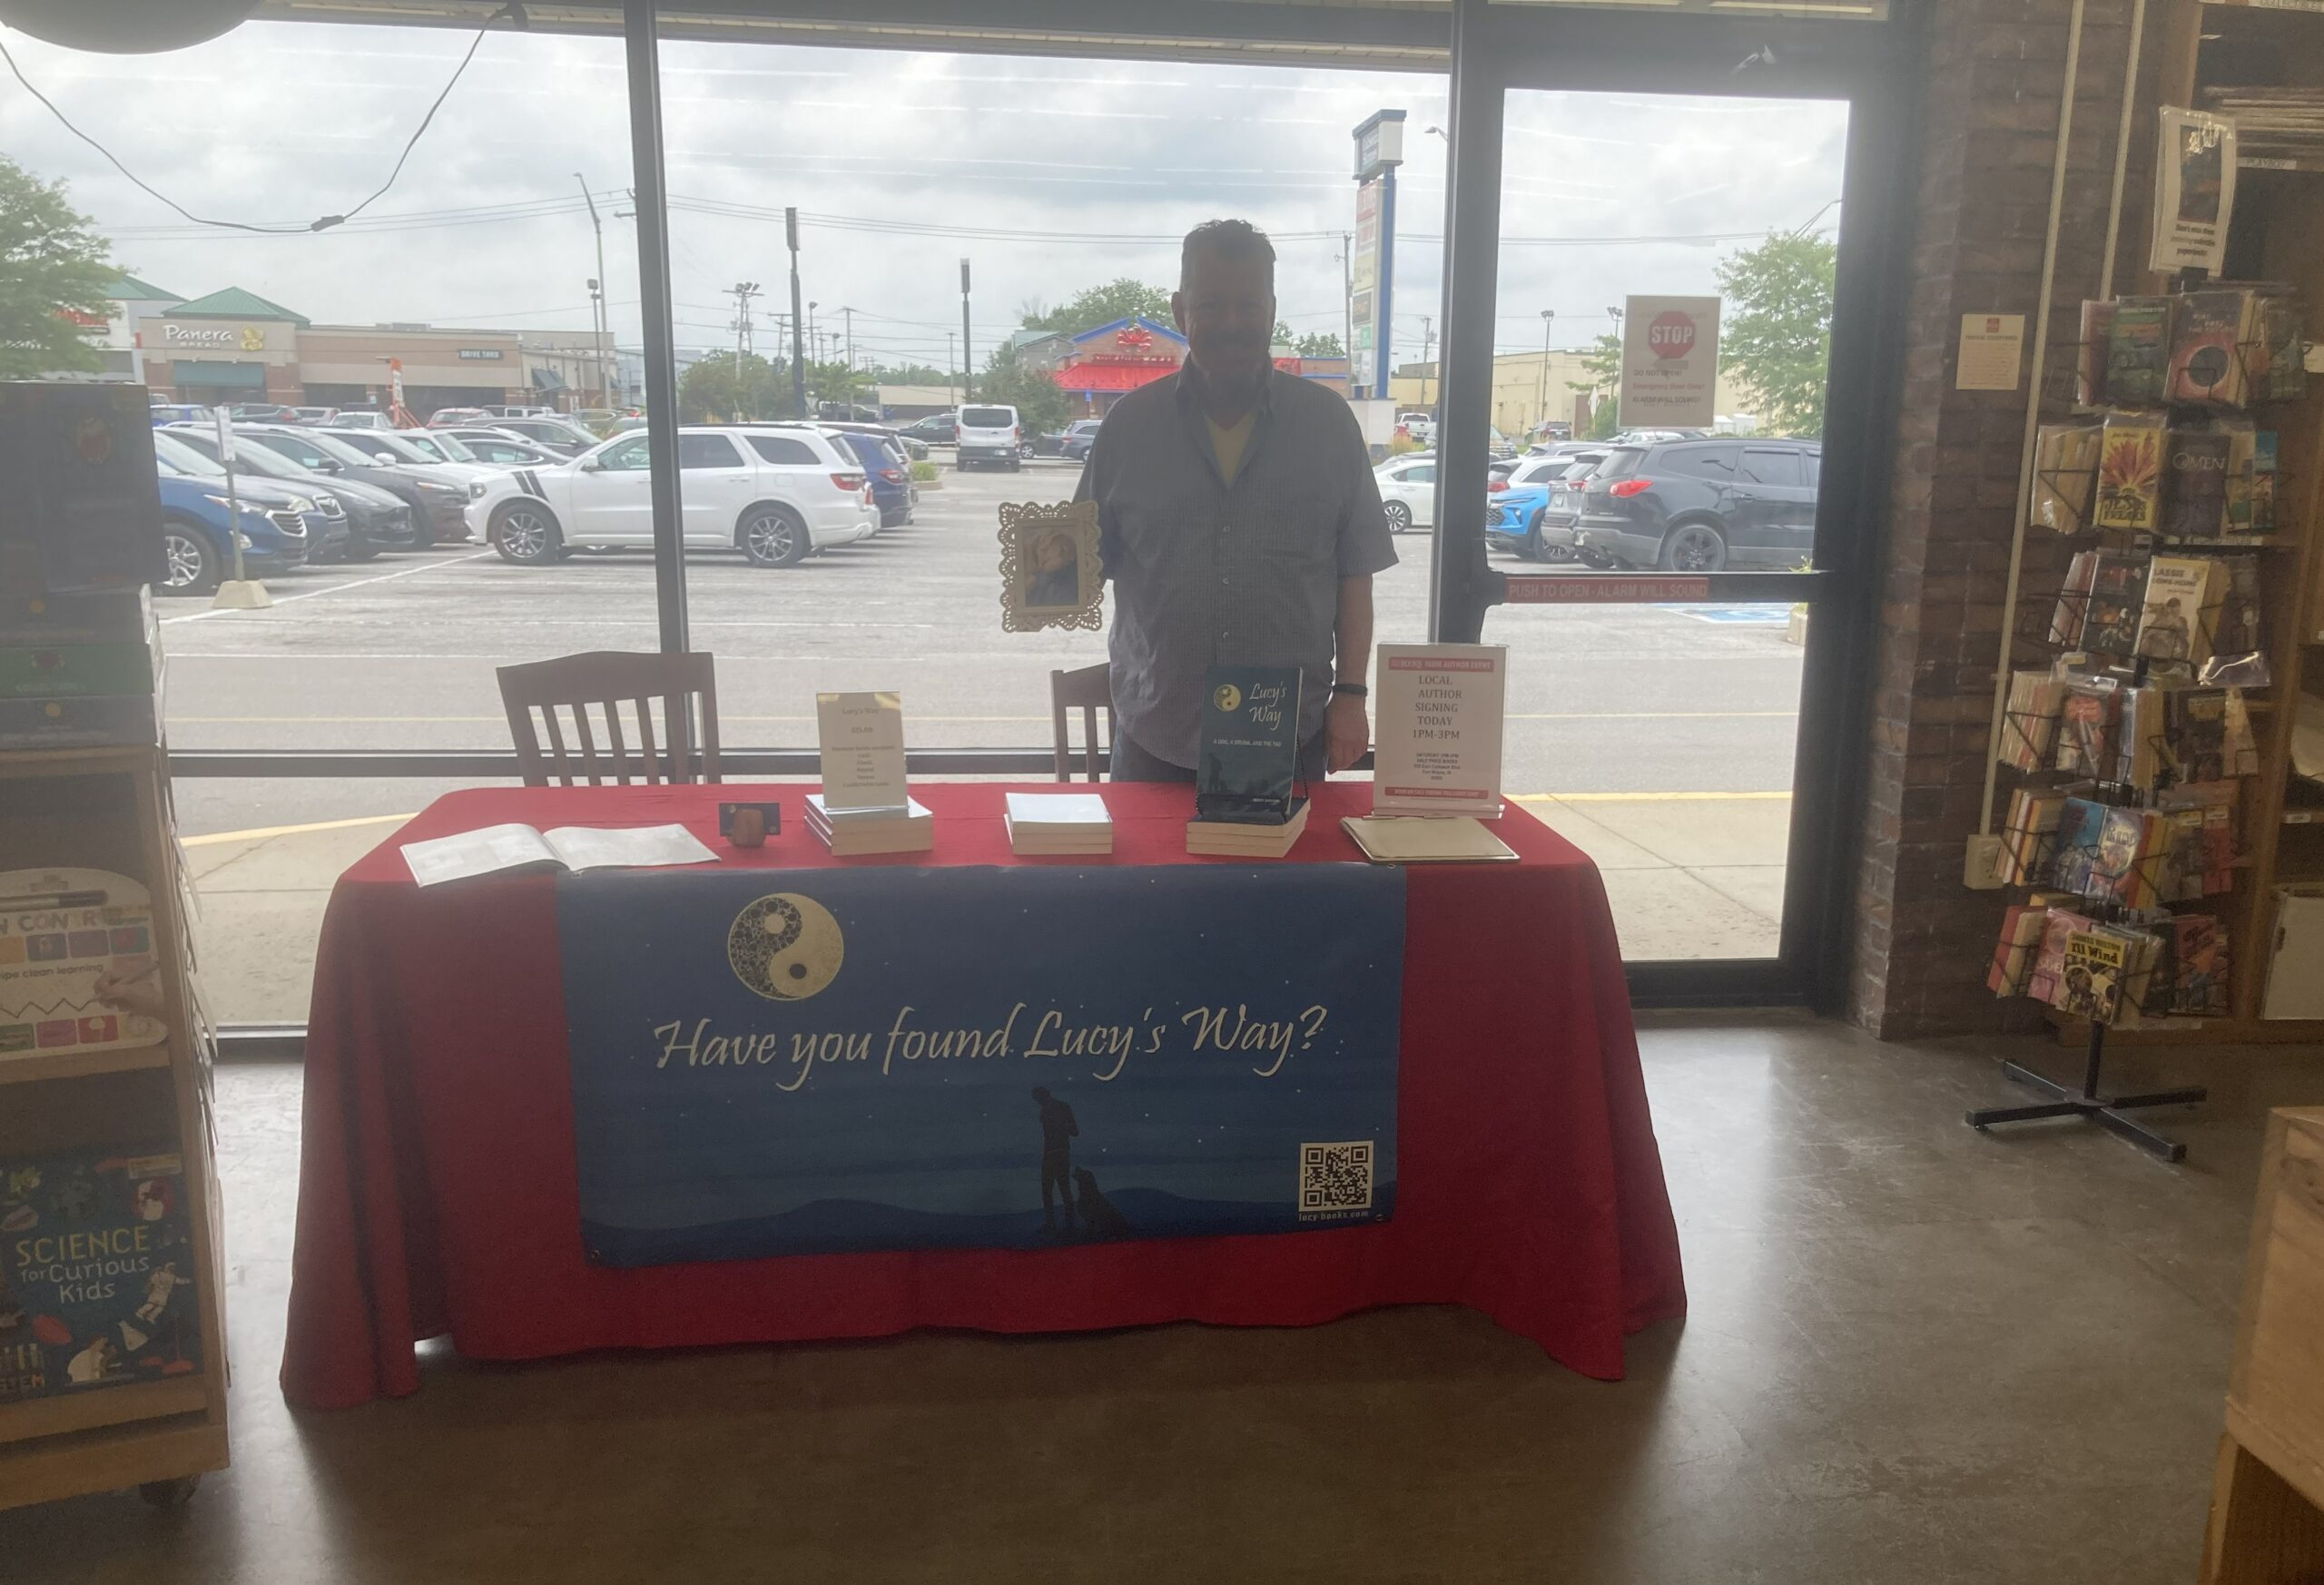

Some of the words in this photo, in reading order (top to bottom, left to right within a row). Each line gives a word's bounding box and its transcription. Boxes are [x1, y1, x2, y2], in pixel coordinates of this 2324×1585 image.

[162, 324, 233, 341] Panera
[1651, 326, 1693, 345] STOP
[460, 350, 481, 359] DRIVE
[2171, 452, 2225, 470] OMEN
[1509, 584, 1539, 597] PUSH
[1541, 584, 1556, 597] TO
[1640, 584, 1666, 597] WILL
[1669, 584, 1708, 597] SOUND
[1418, 675, 1452, 685] LOCAL
[1249, 681, 1287, 708] Lucy's
[1418, 690, 1462, 699] AUTHOR
[1415, 703, 1458, 713] SIGNING
[1249, 706, 1282, 731] Way
[1417, 716, 1452, 725] TODAY
[1413, 729, 1460, 740] 1PM-3PM
[2089, 945, 2119, 963] Wind
[23, 967, 54, 978] clean
[57, 962, 103, 975] learning
[654, 1018, 775, 1068] Have
[775, 1031, 872, 1092] you
[881, 1001, 1027, 1077] found
[1023, 1007, 1166, 1081] Lucy's
[1181, 1004, 1327, 1078] Way?
[16, 1226, 150, 1267] SCIENCE
[22, 1270, 46, 1284] for
[49, 1256, 150, 1284] Curious
[60, 1281, 116, 1304] Kids
